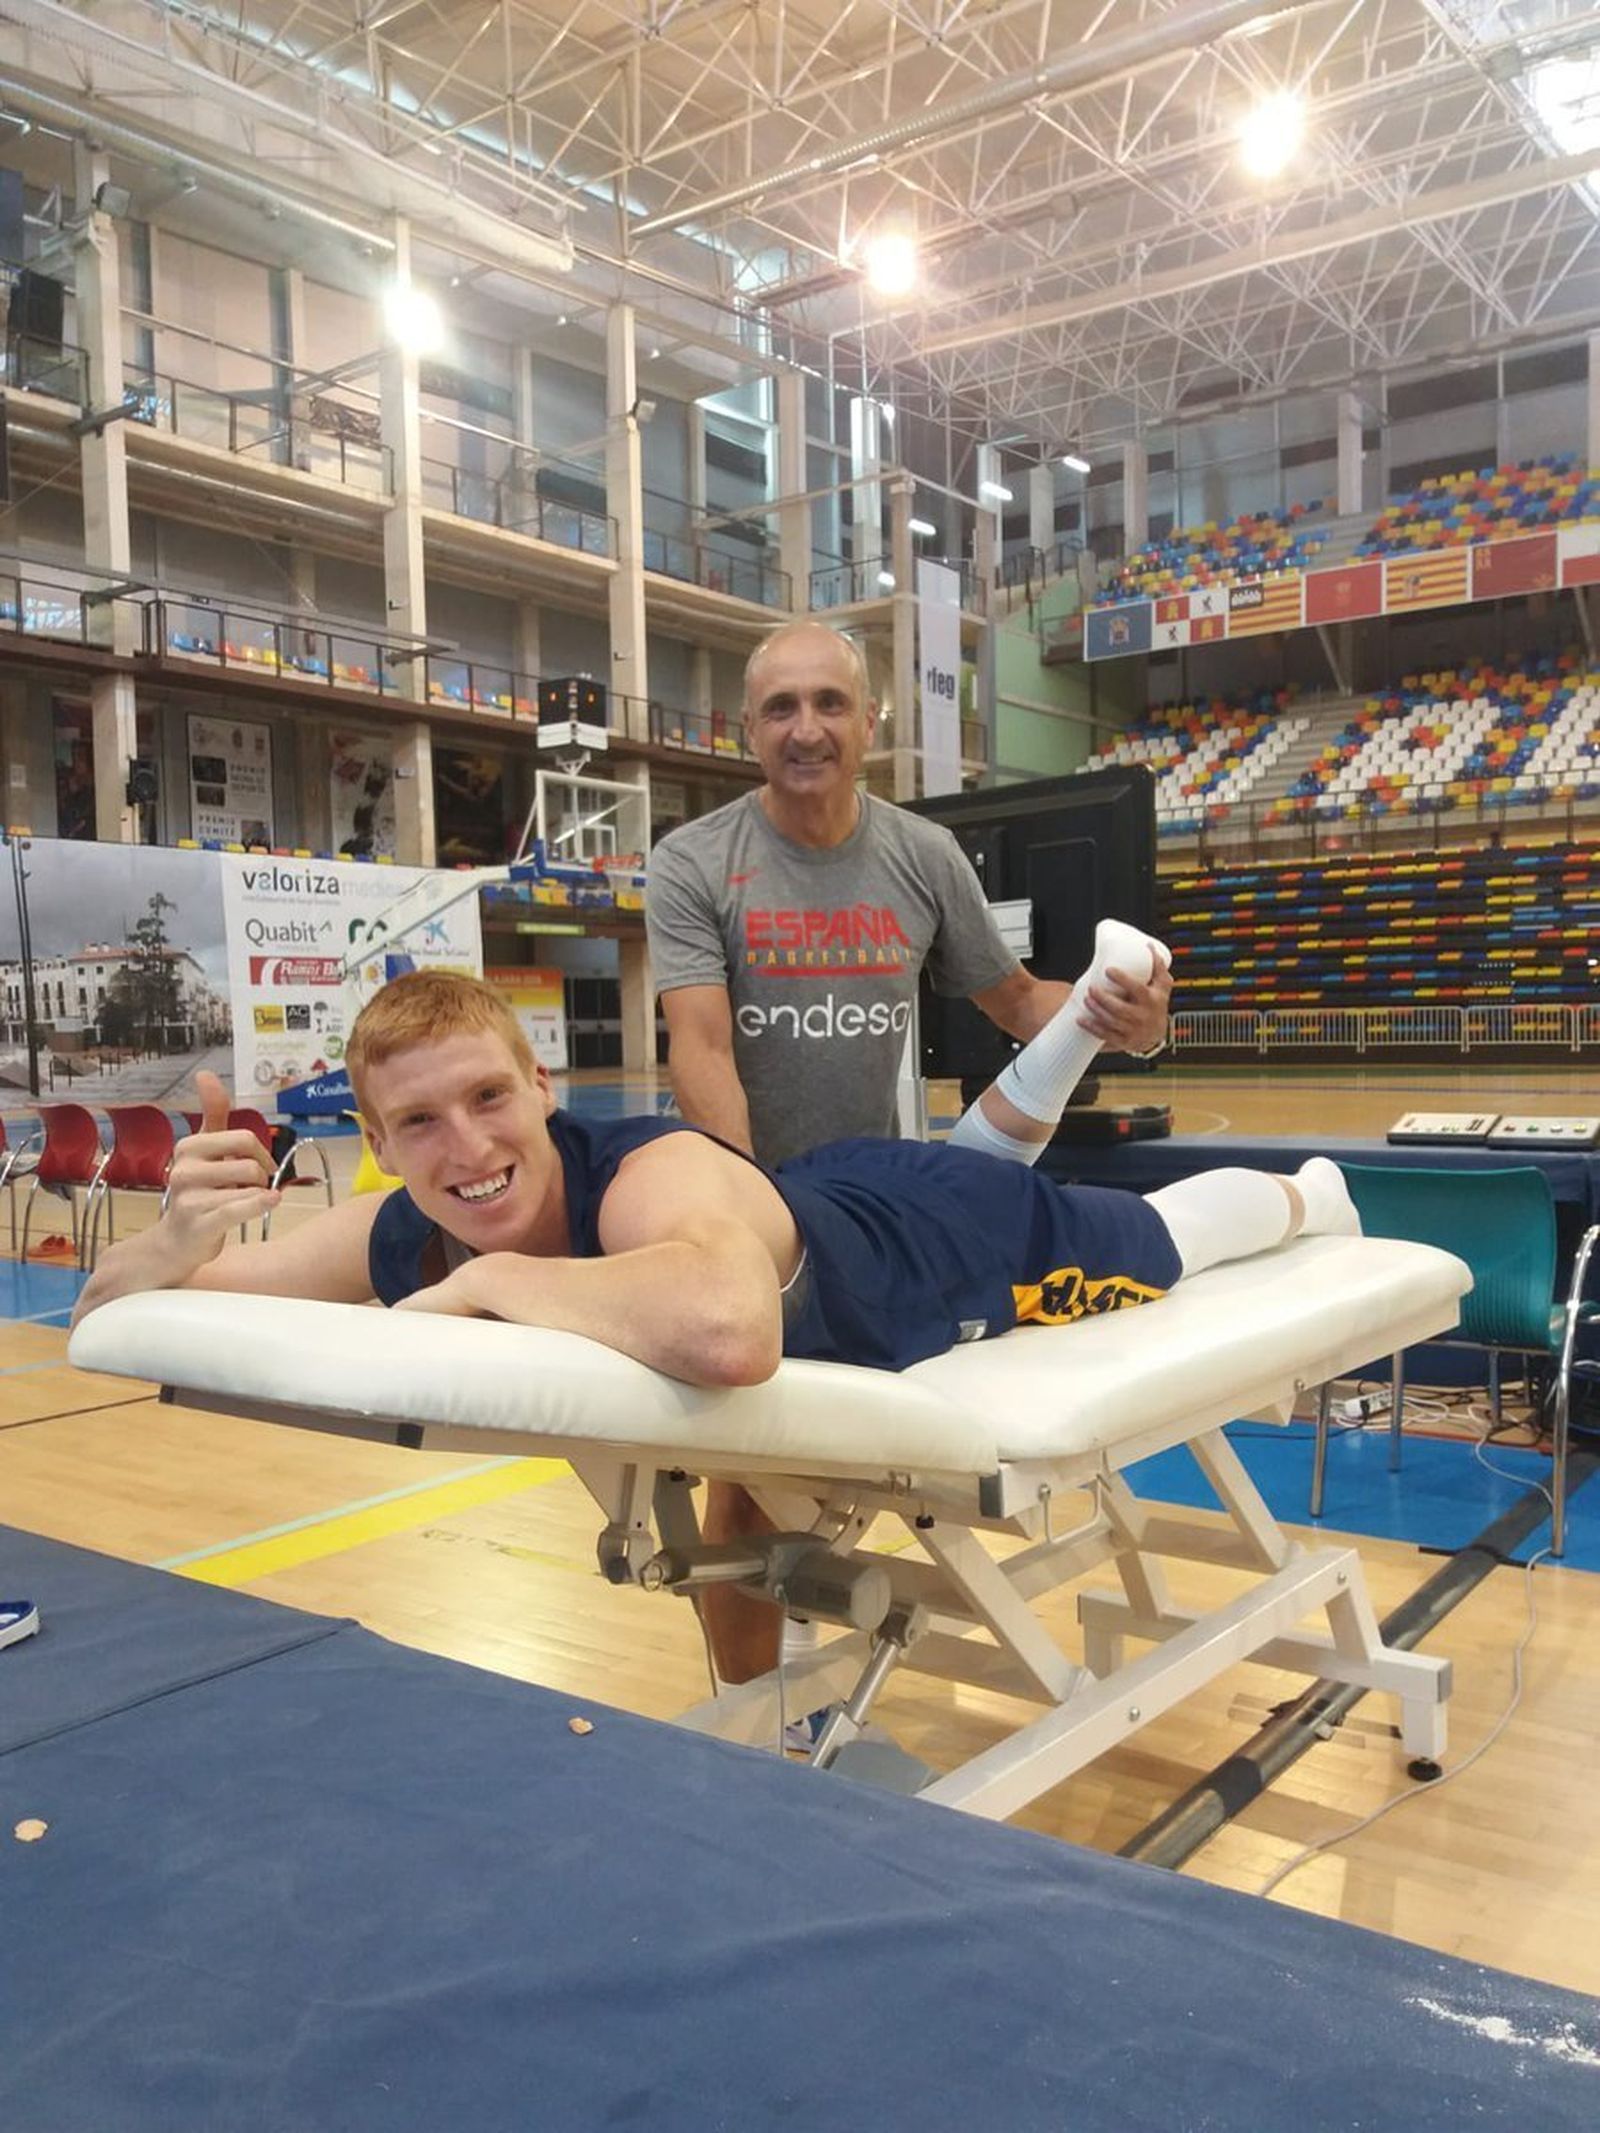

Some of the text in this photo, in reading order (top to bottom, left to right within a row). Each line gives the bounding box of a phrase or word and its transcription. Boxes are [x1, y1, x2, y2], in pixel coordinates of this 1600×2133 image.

[242, 866, 340, 895] valoriza
[245, 918, 317, 947] Quabit
[745, 901, 911, 948] ESPAÑA
